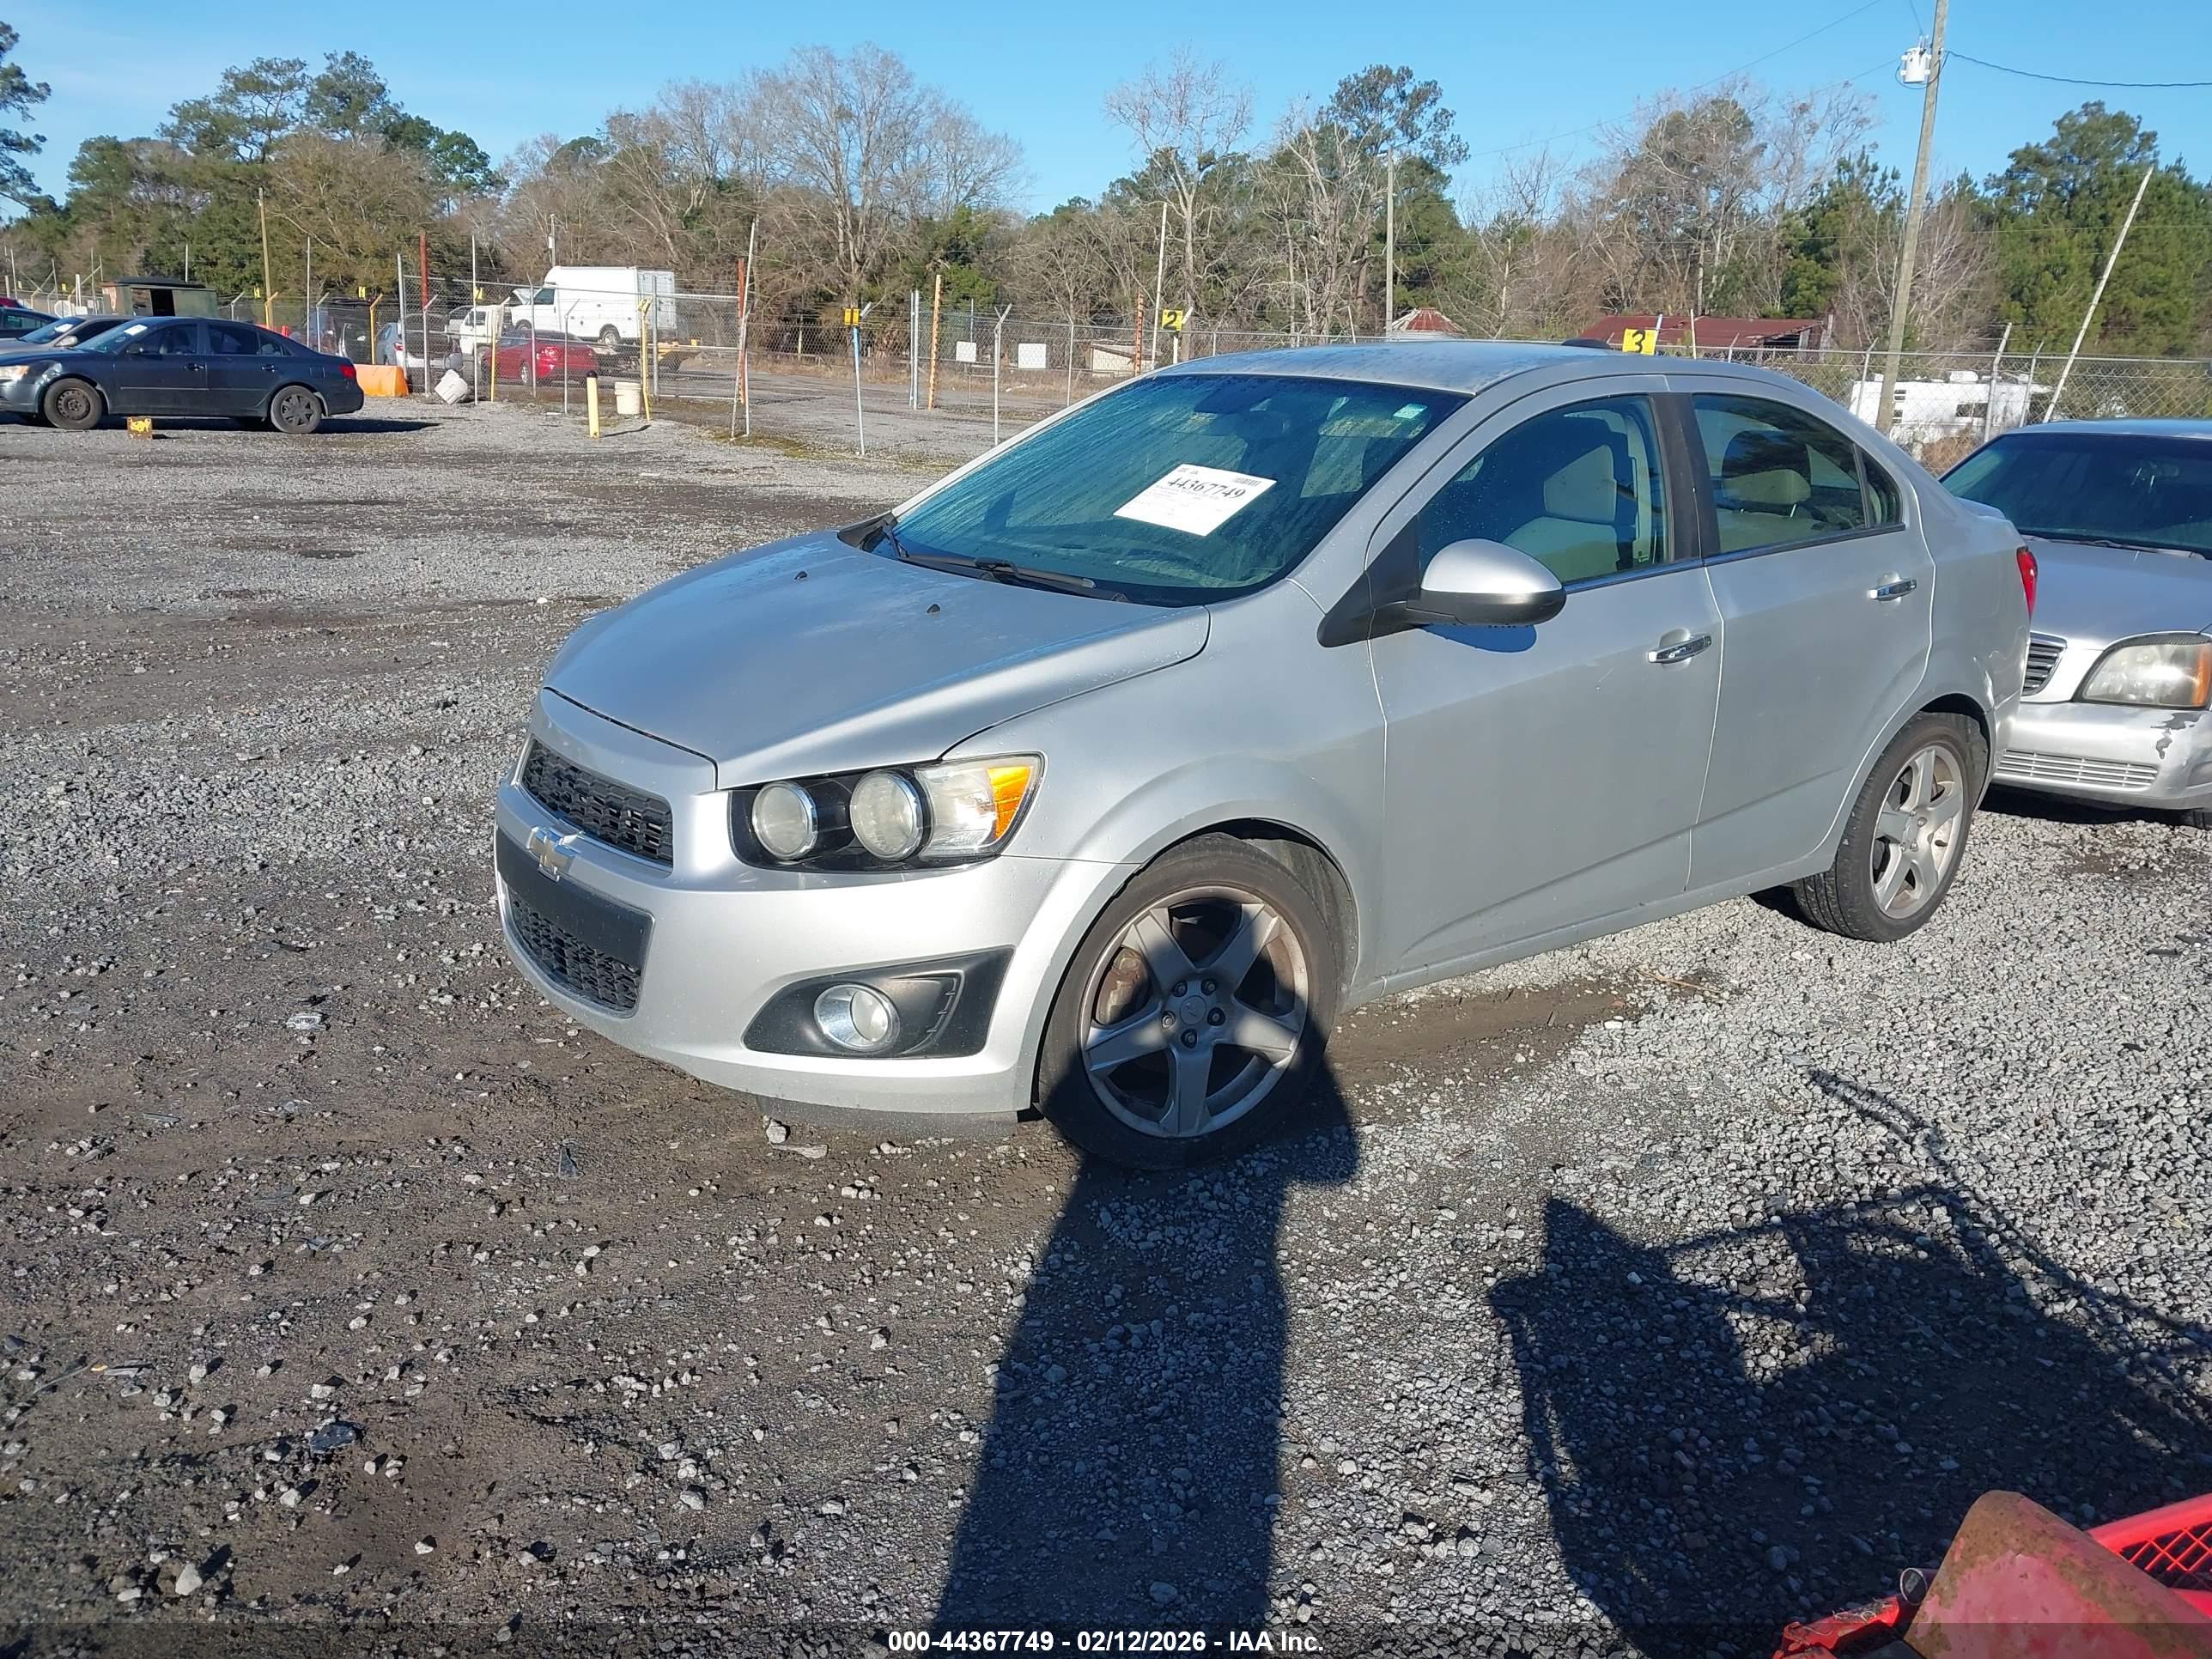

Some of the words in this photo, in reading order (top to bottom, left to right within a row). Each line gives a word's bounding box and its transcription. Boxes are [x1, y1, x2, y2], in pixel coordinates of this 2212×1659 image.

[1163, 311, 1177, 331] 2
[1632, 329, 1646, 353] 3
[1167, 477, 1247, 499] 44367749
